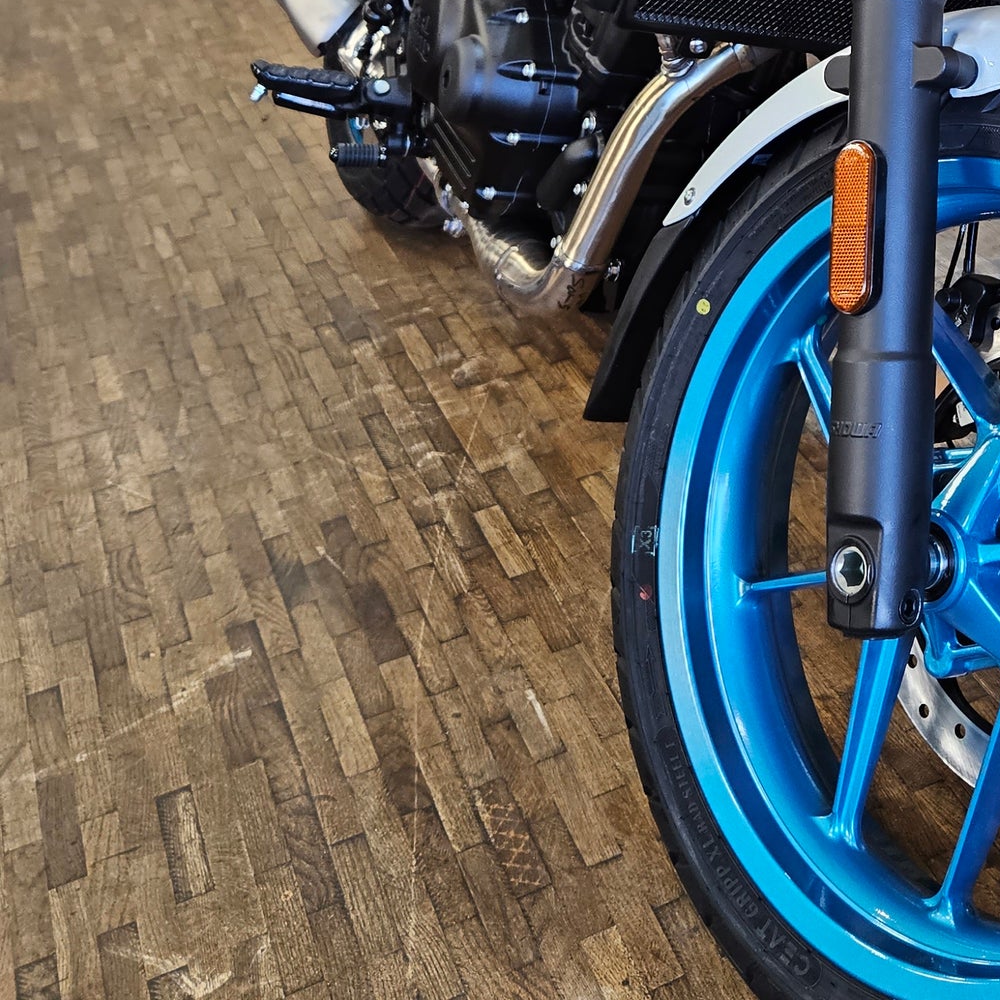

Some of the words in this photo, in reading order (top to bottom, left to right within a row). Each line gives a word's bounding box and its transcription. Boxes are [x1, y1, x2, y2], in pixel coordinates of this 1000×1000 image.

[700, 839, 723, 865] XL
[714, 864, 758, 919] GRIPP
[755, 920, 810, 976] CEAT
